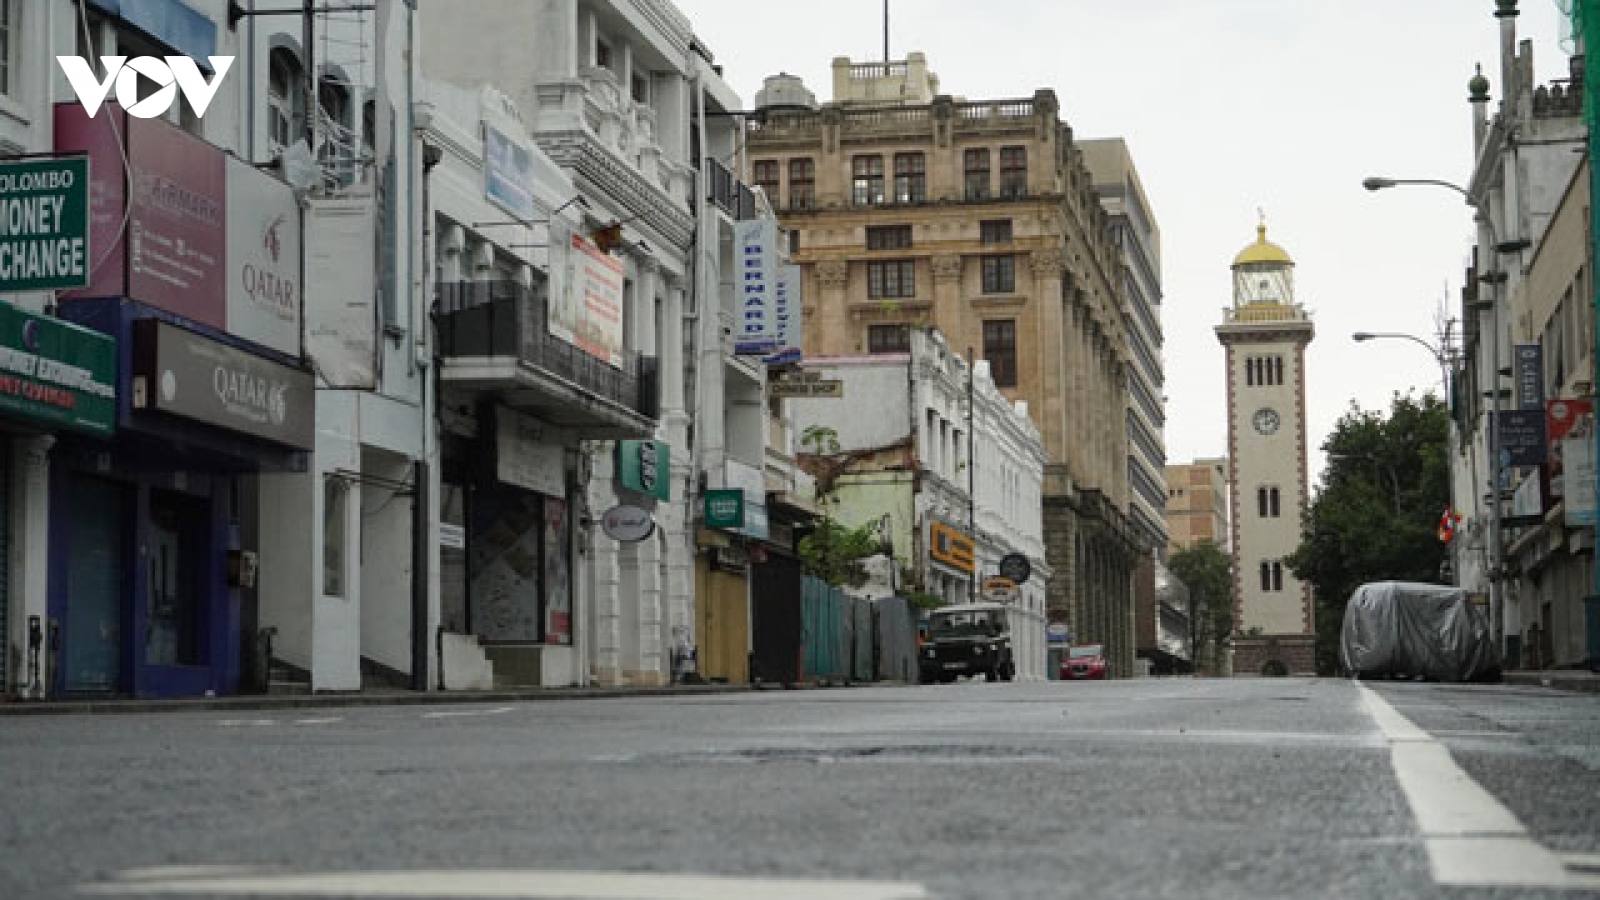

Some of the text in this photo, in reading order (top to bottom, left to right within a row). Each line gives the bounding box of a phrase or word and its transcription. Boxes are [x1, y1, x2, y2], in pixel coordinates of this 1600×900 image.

[242, 264, 294, 310] QATAR
[744, 244, 766, 334] BERNARD
[213, 366, 267, 408] QATAR
